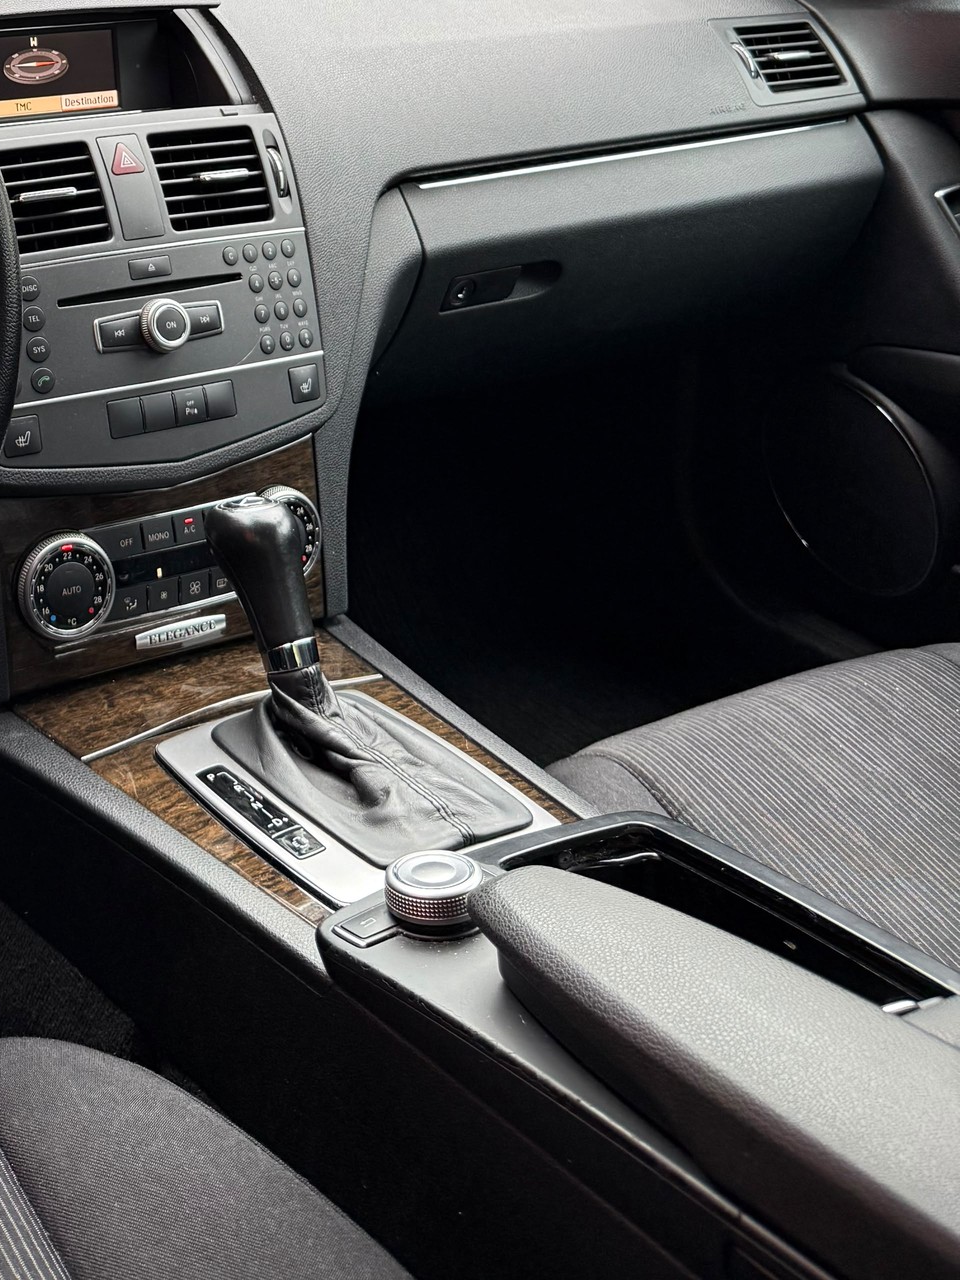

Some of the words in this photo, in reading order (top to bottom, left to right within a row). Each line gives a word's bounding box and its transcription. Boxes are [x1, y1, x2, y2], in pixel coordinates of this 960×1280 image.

[15, 102, 31, 111] TMC
[65, 95, 114, 107] Destination
[22, 284, 38, 292] DISC
[28, 315, 40, 323] TEL
[33, 345, 46, 353] SYS
[120, 538, 133, 547] OFF
[148, 531, 169, 541] MONO
[184, 525, 195, 533] A/C
[63, 552, 72, 560] 22
[62, 586, 81, 596] AUTO
[94, 596, 102, 604] 28
[42, 607, 50, 615] 16
[148, 620, 216, 644] ELEGANCE
